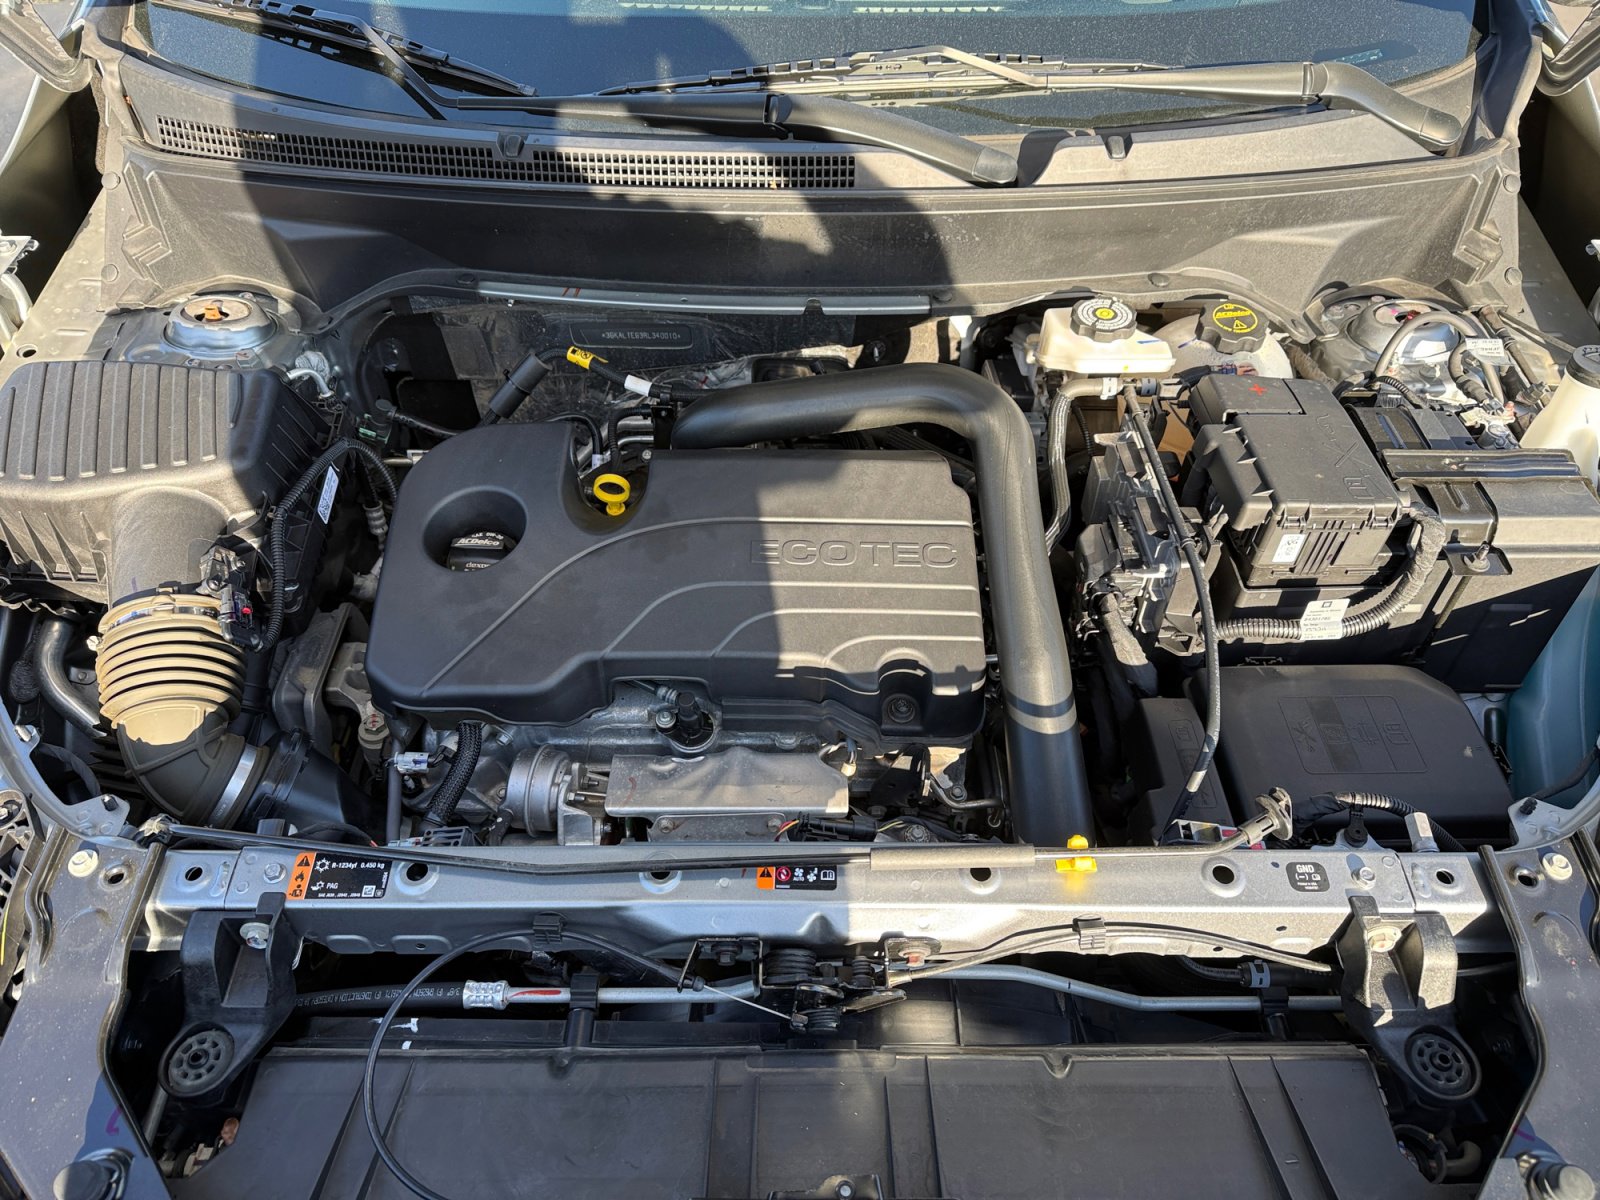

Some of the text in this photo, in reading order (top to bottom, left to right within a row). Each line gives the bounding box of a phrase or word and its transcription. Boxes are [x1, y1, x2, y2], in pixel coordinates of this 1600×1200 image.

[457, 537, 500, 546] ACDelco
[750, 539, 959, 569] ECOTEC
[331, 861, 385, 870] R-1234yf 0.450 kg
[1296, 864, 1315, 873] GND
